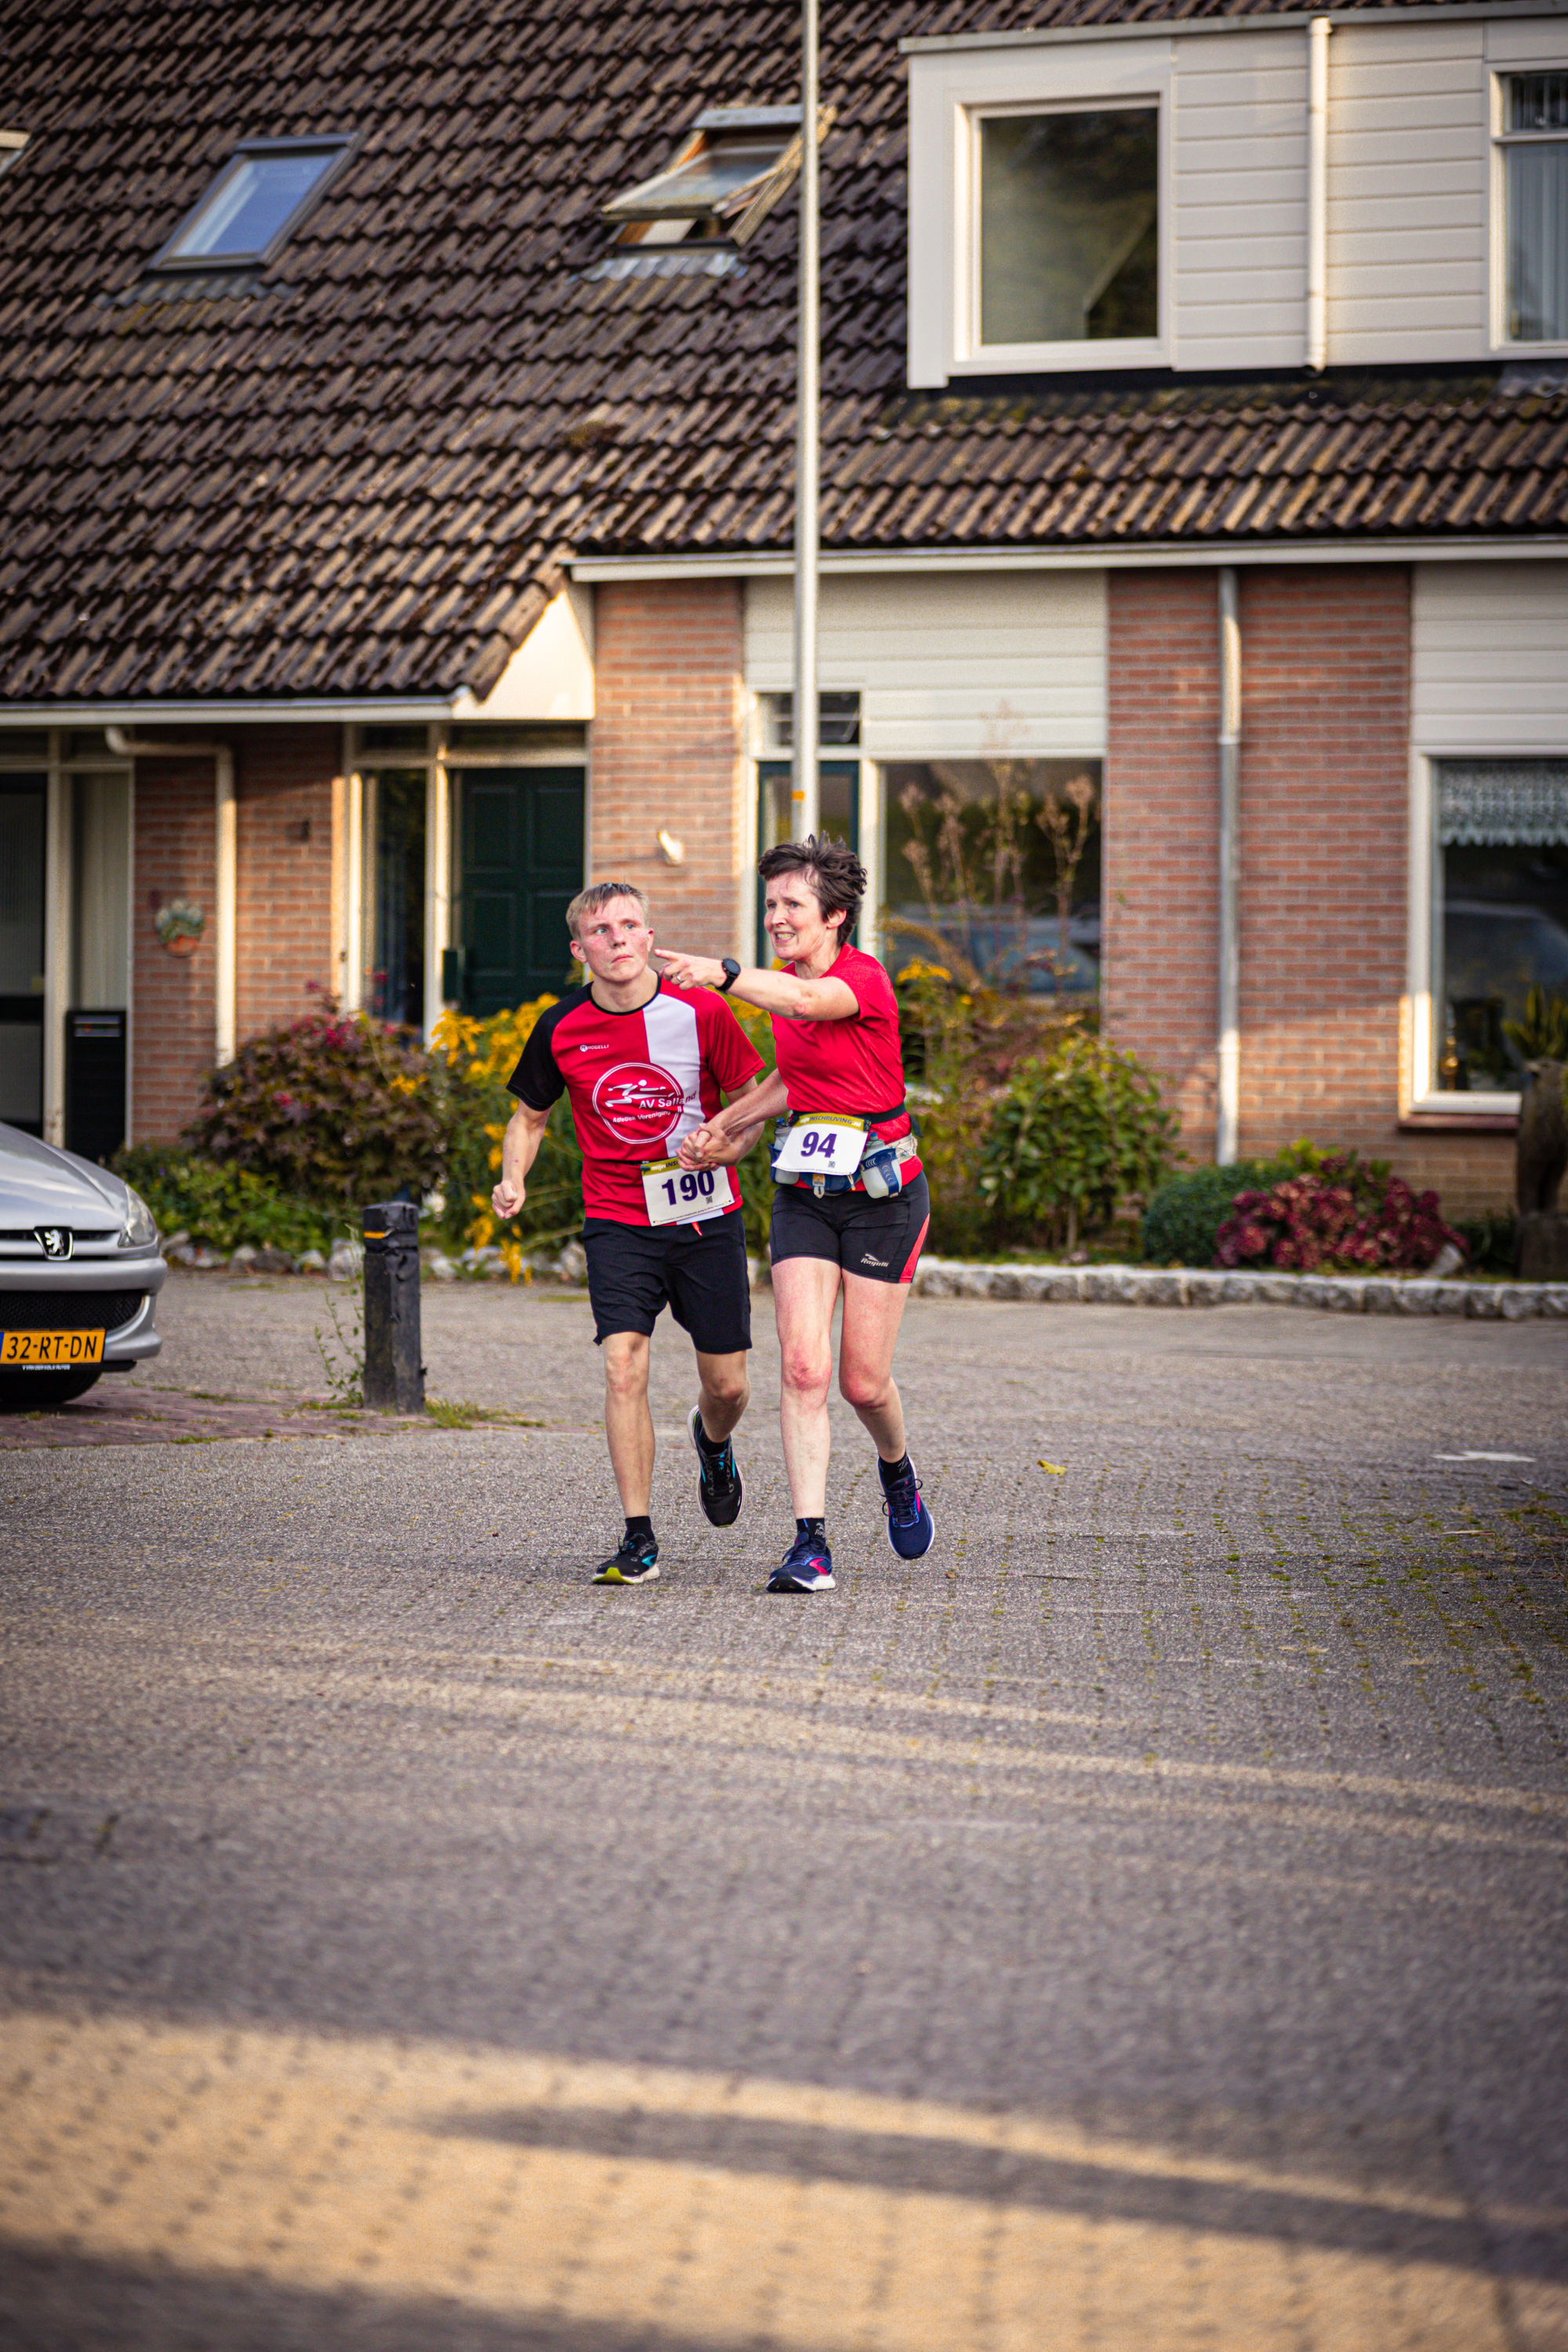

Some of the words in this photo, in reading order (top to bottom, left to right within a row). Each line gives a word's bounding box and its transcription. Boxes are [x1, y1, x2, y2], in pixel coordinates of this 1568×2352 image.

[639, 1098, 655, 1109] AV
[658, 1090, 697, 1108] Salland
[637, 1110, 671, 1120] Vereniging
[800, 1131, 837, 1158] 94
[662, 1171, 714, 1206] 190
[7, 1336, 97, 1359] 32-RT-DN
